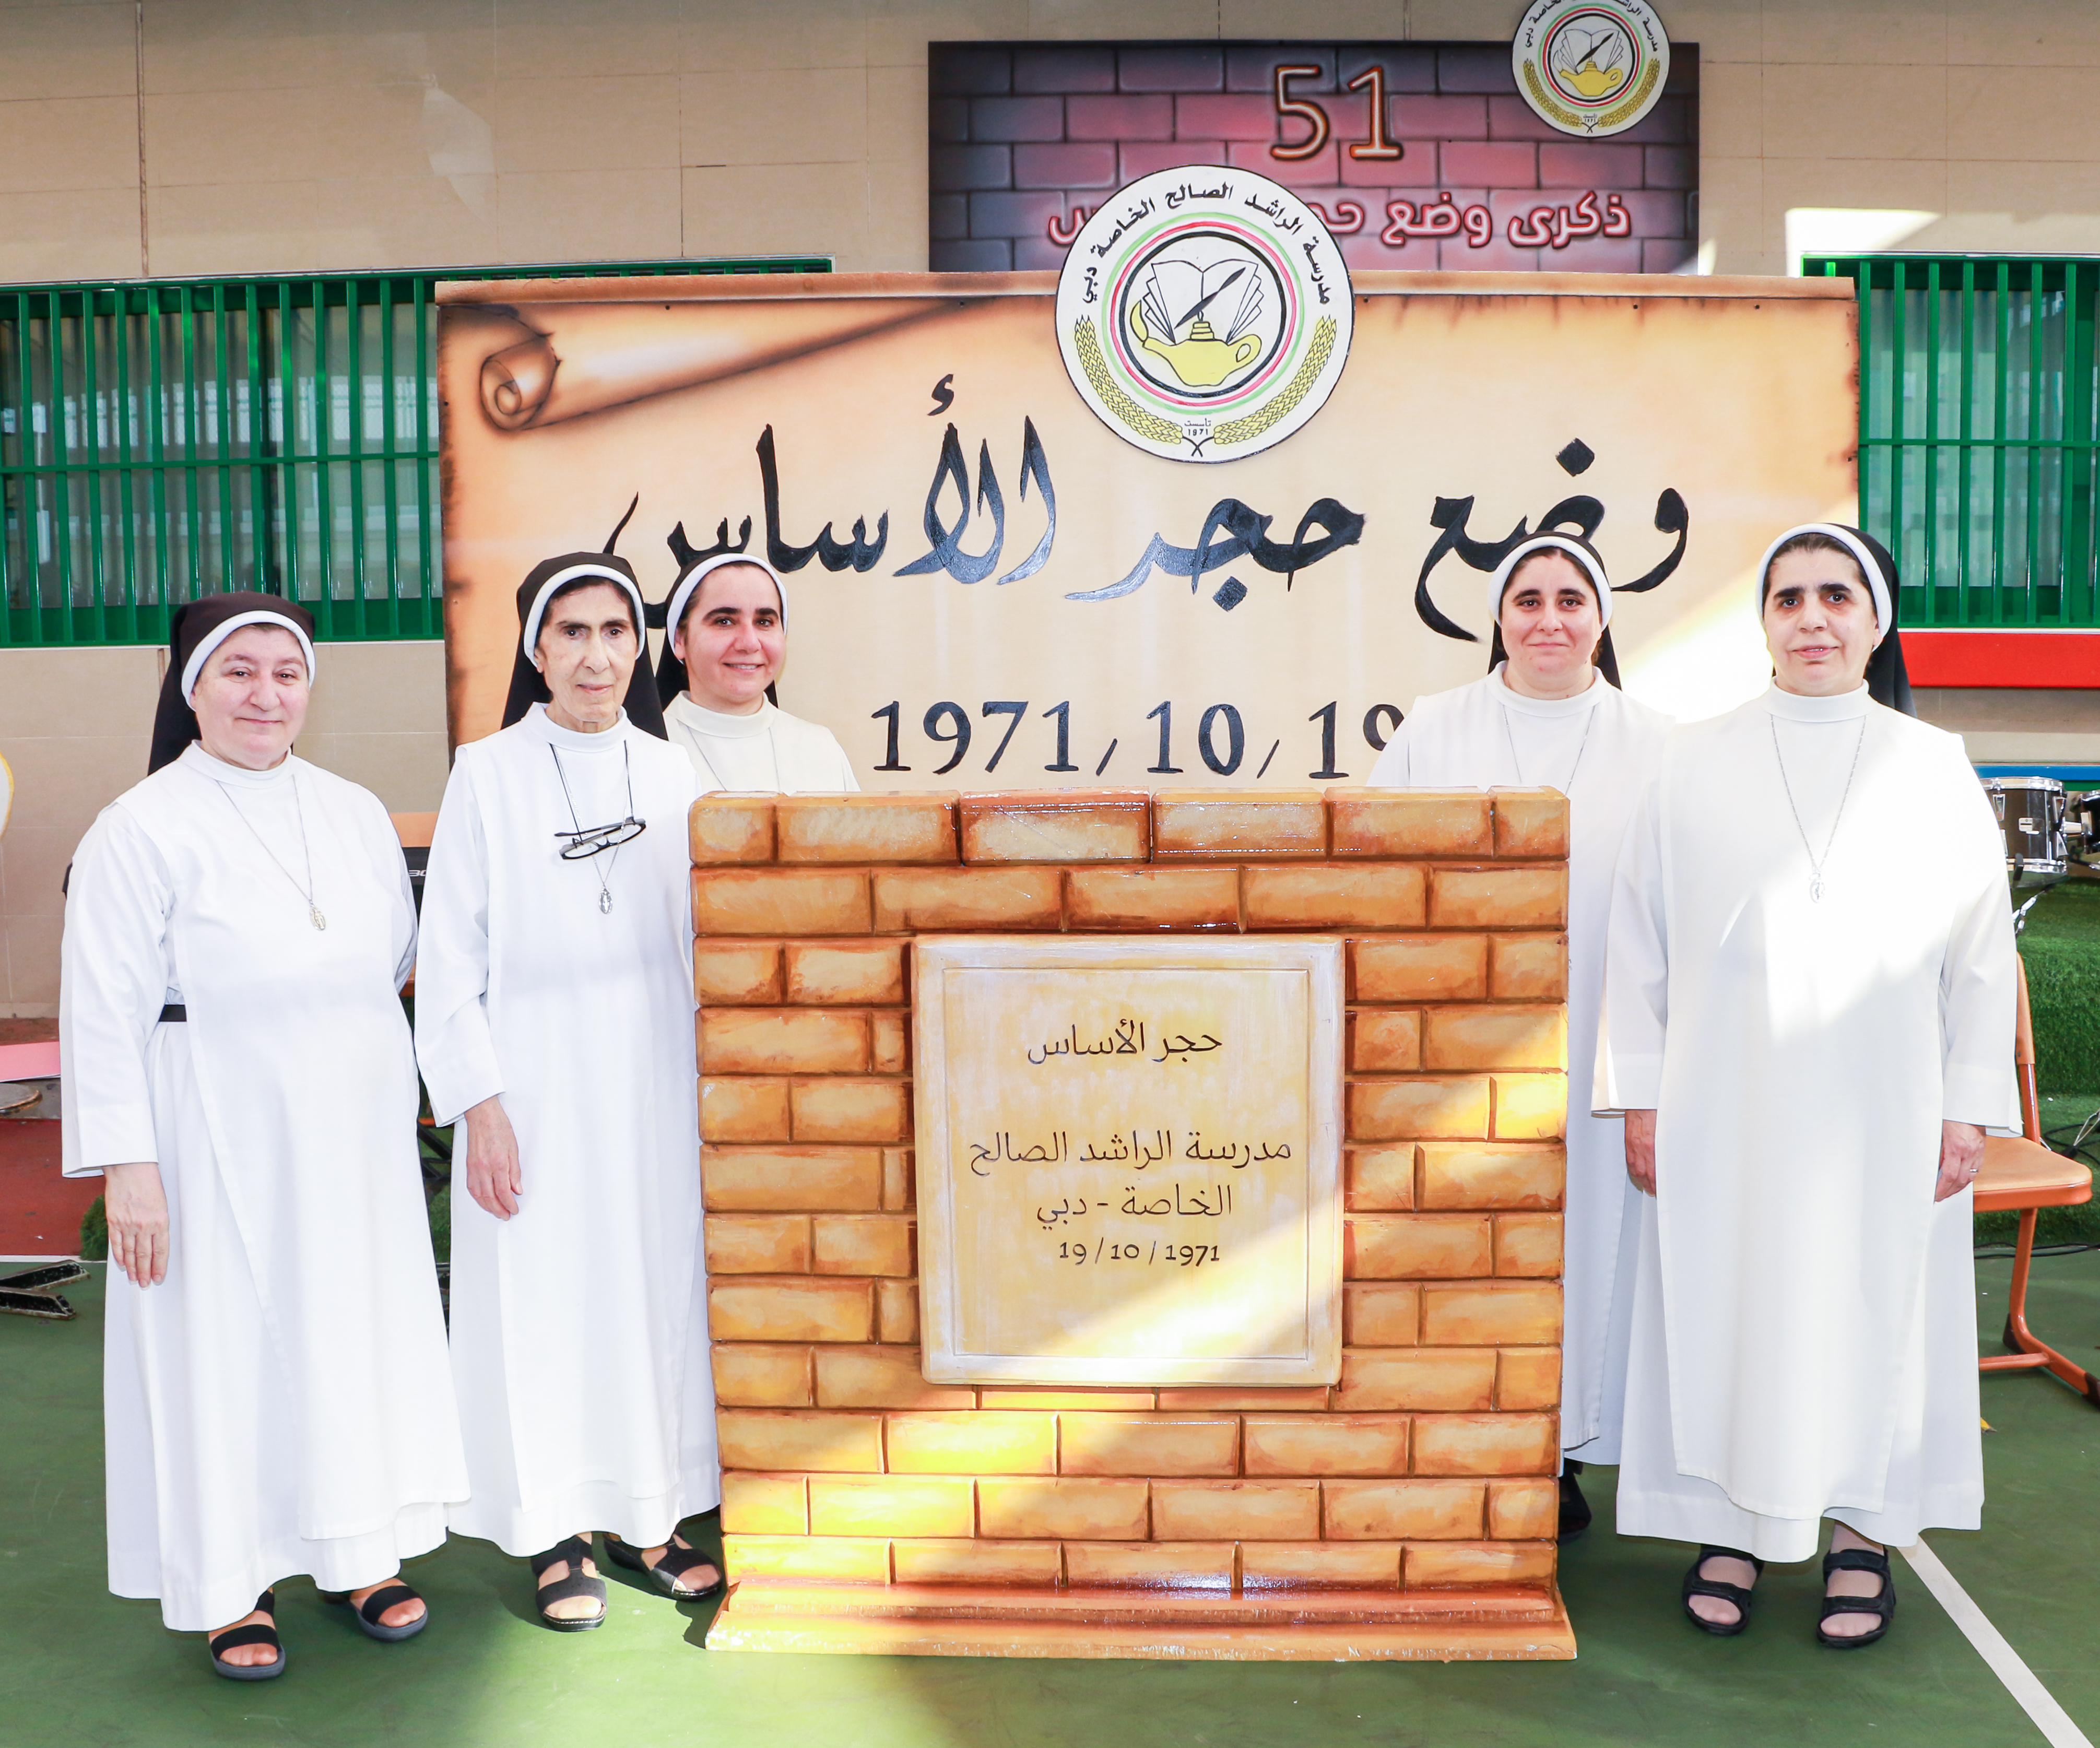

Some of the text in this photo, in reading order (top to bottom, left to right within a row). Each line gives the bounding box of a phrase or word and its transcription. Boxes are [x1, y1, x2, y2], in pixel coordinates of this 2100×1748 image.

[1528, 0, 1562, 24] خاصة
[1613, 0, 1642, 16] الراش
[1270, 65, 1403, 160] 51
[1165, 181, 1234, 209] الصالح
[1244, 193, 1304, 235] الراشد
[1090, 196, 1155, 258] الخاصة
[1382, 192, 1493, 248] وضع
[1508, 190, 1632, 249] ذكرى
[1082, 267, 1099, 304] دبي
[1303, 236, 1331, 304] مدرسة
[1188, 428, 1208, 436] 1971
[1064, 497, 1366, 612] حجر
[1028, 1019, 1223, 1065] حجر الأساس
[970, 1130, 1291, 1176] مدرسة الراشد الصالح
[1037, 1198, 1087, 1231] دبي
[1121, 1183, 1231, 1216] الخاصة
